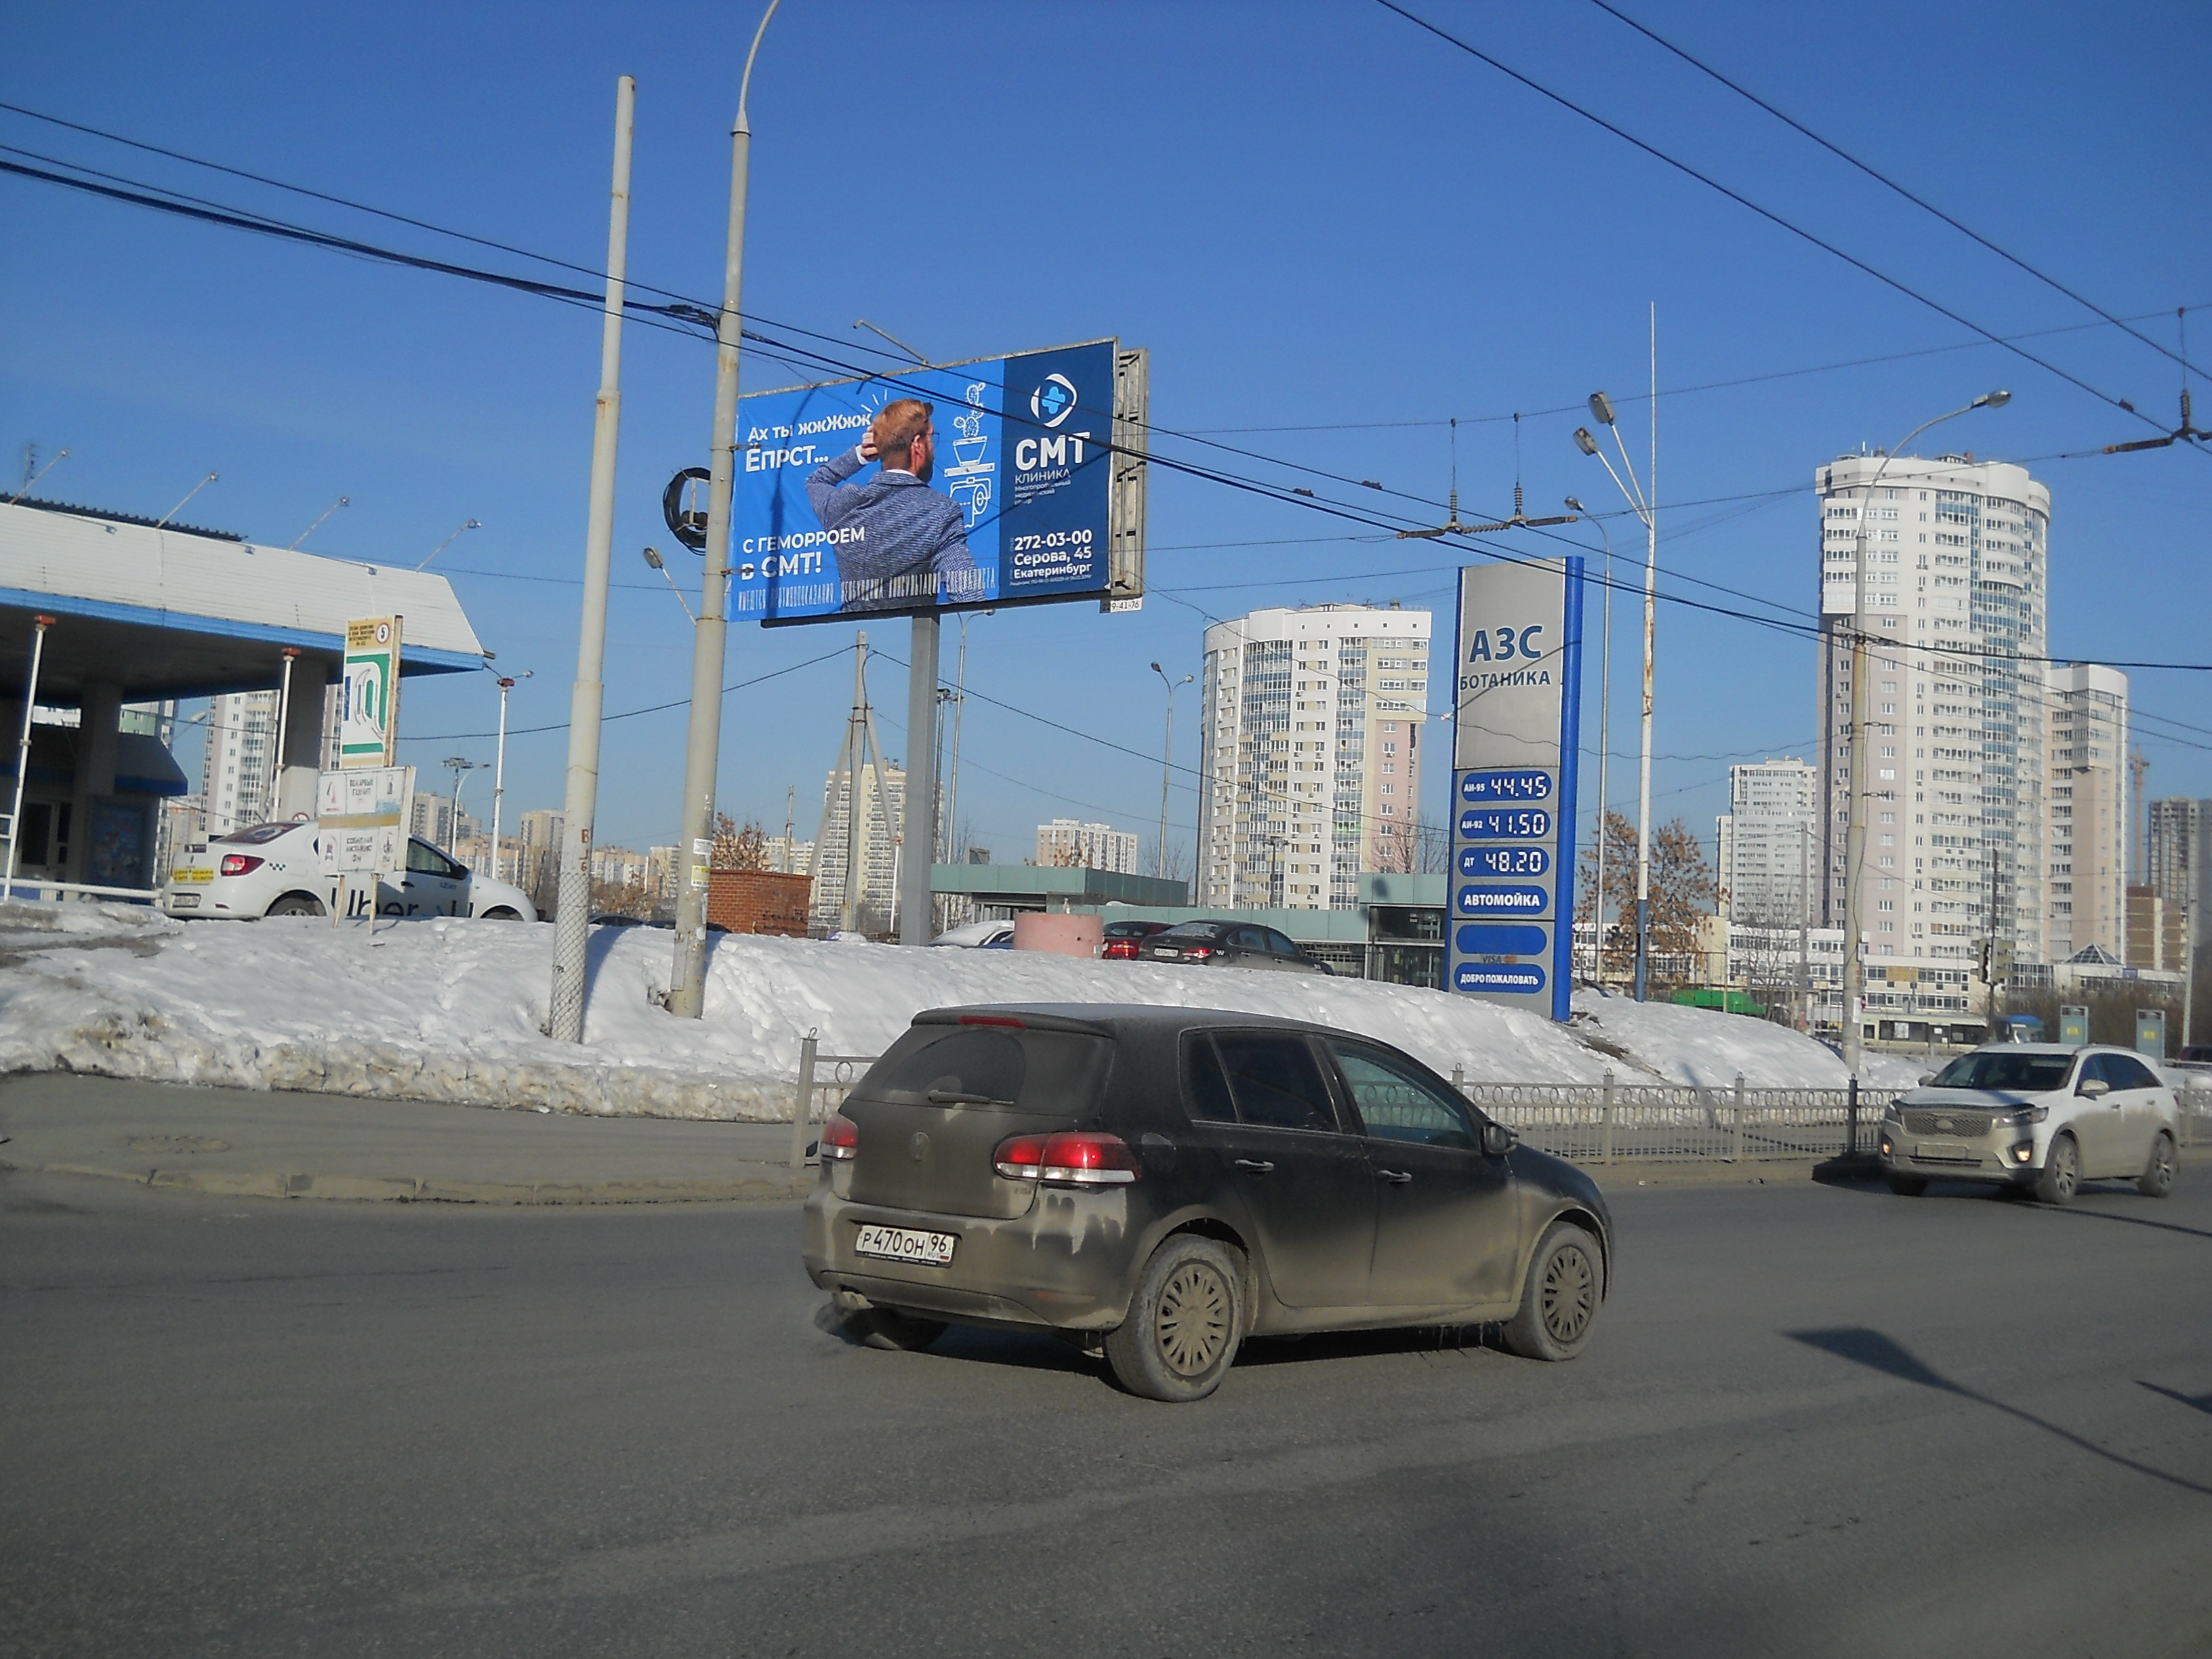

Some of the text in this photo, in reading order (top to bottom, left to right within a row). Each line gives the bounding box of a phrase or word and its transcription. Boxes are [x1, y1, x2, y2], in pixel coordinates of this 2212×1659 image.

[747, 427, 769, 443] Ах
[772, 424, 794, 438] ты
[1016, 432, 1090, 470] СМТ
[1015, 468, 1071, 485] КЛИНИКА
[758, 527, 865, 552] ГЕМОРРОЕМ
[1015, 529, 1092, 551] 272-03-00
[761, 552, 822, 578] СМТ!
[1014, 546, 1092, 567] Серова, 45
[1014, 563, 1092, 579] Екатеринбург
[380, 626, 386, 639] 5
[1469, 624, 1544, 663] АЗС
[1460, 670, 1551, 691] БОТАНИКА
[1464, 776, 1547, 797] АИ-95 44.45
[1462, 814, 1544, 834] АИ-92 41.50
[1464, 851, 1542, 872] ДТ 48.20
[1464, 892, 1540, 907] АВТОМОЙКА
[1482, 956, 1502, 964] VISA
[1460, 974, 1538, 985] ДОБРО ПОЖАЛОВАТЬ
[862, 1229, 947, 1256] Р470ОН 96
